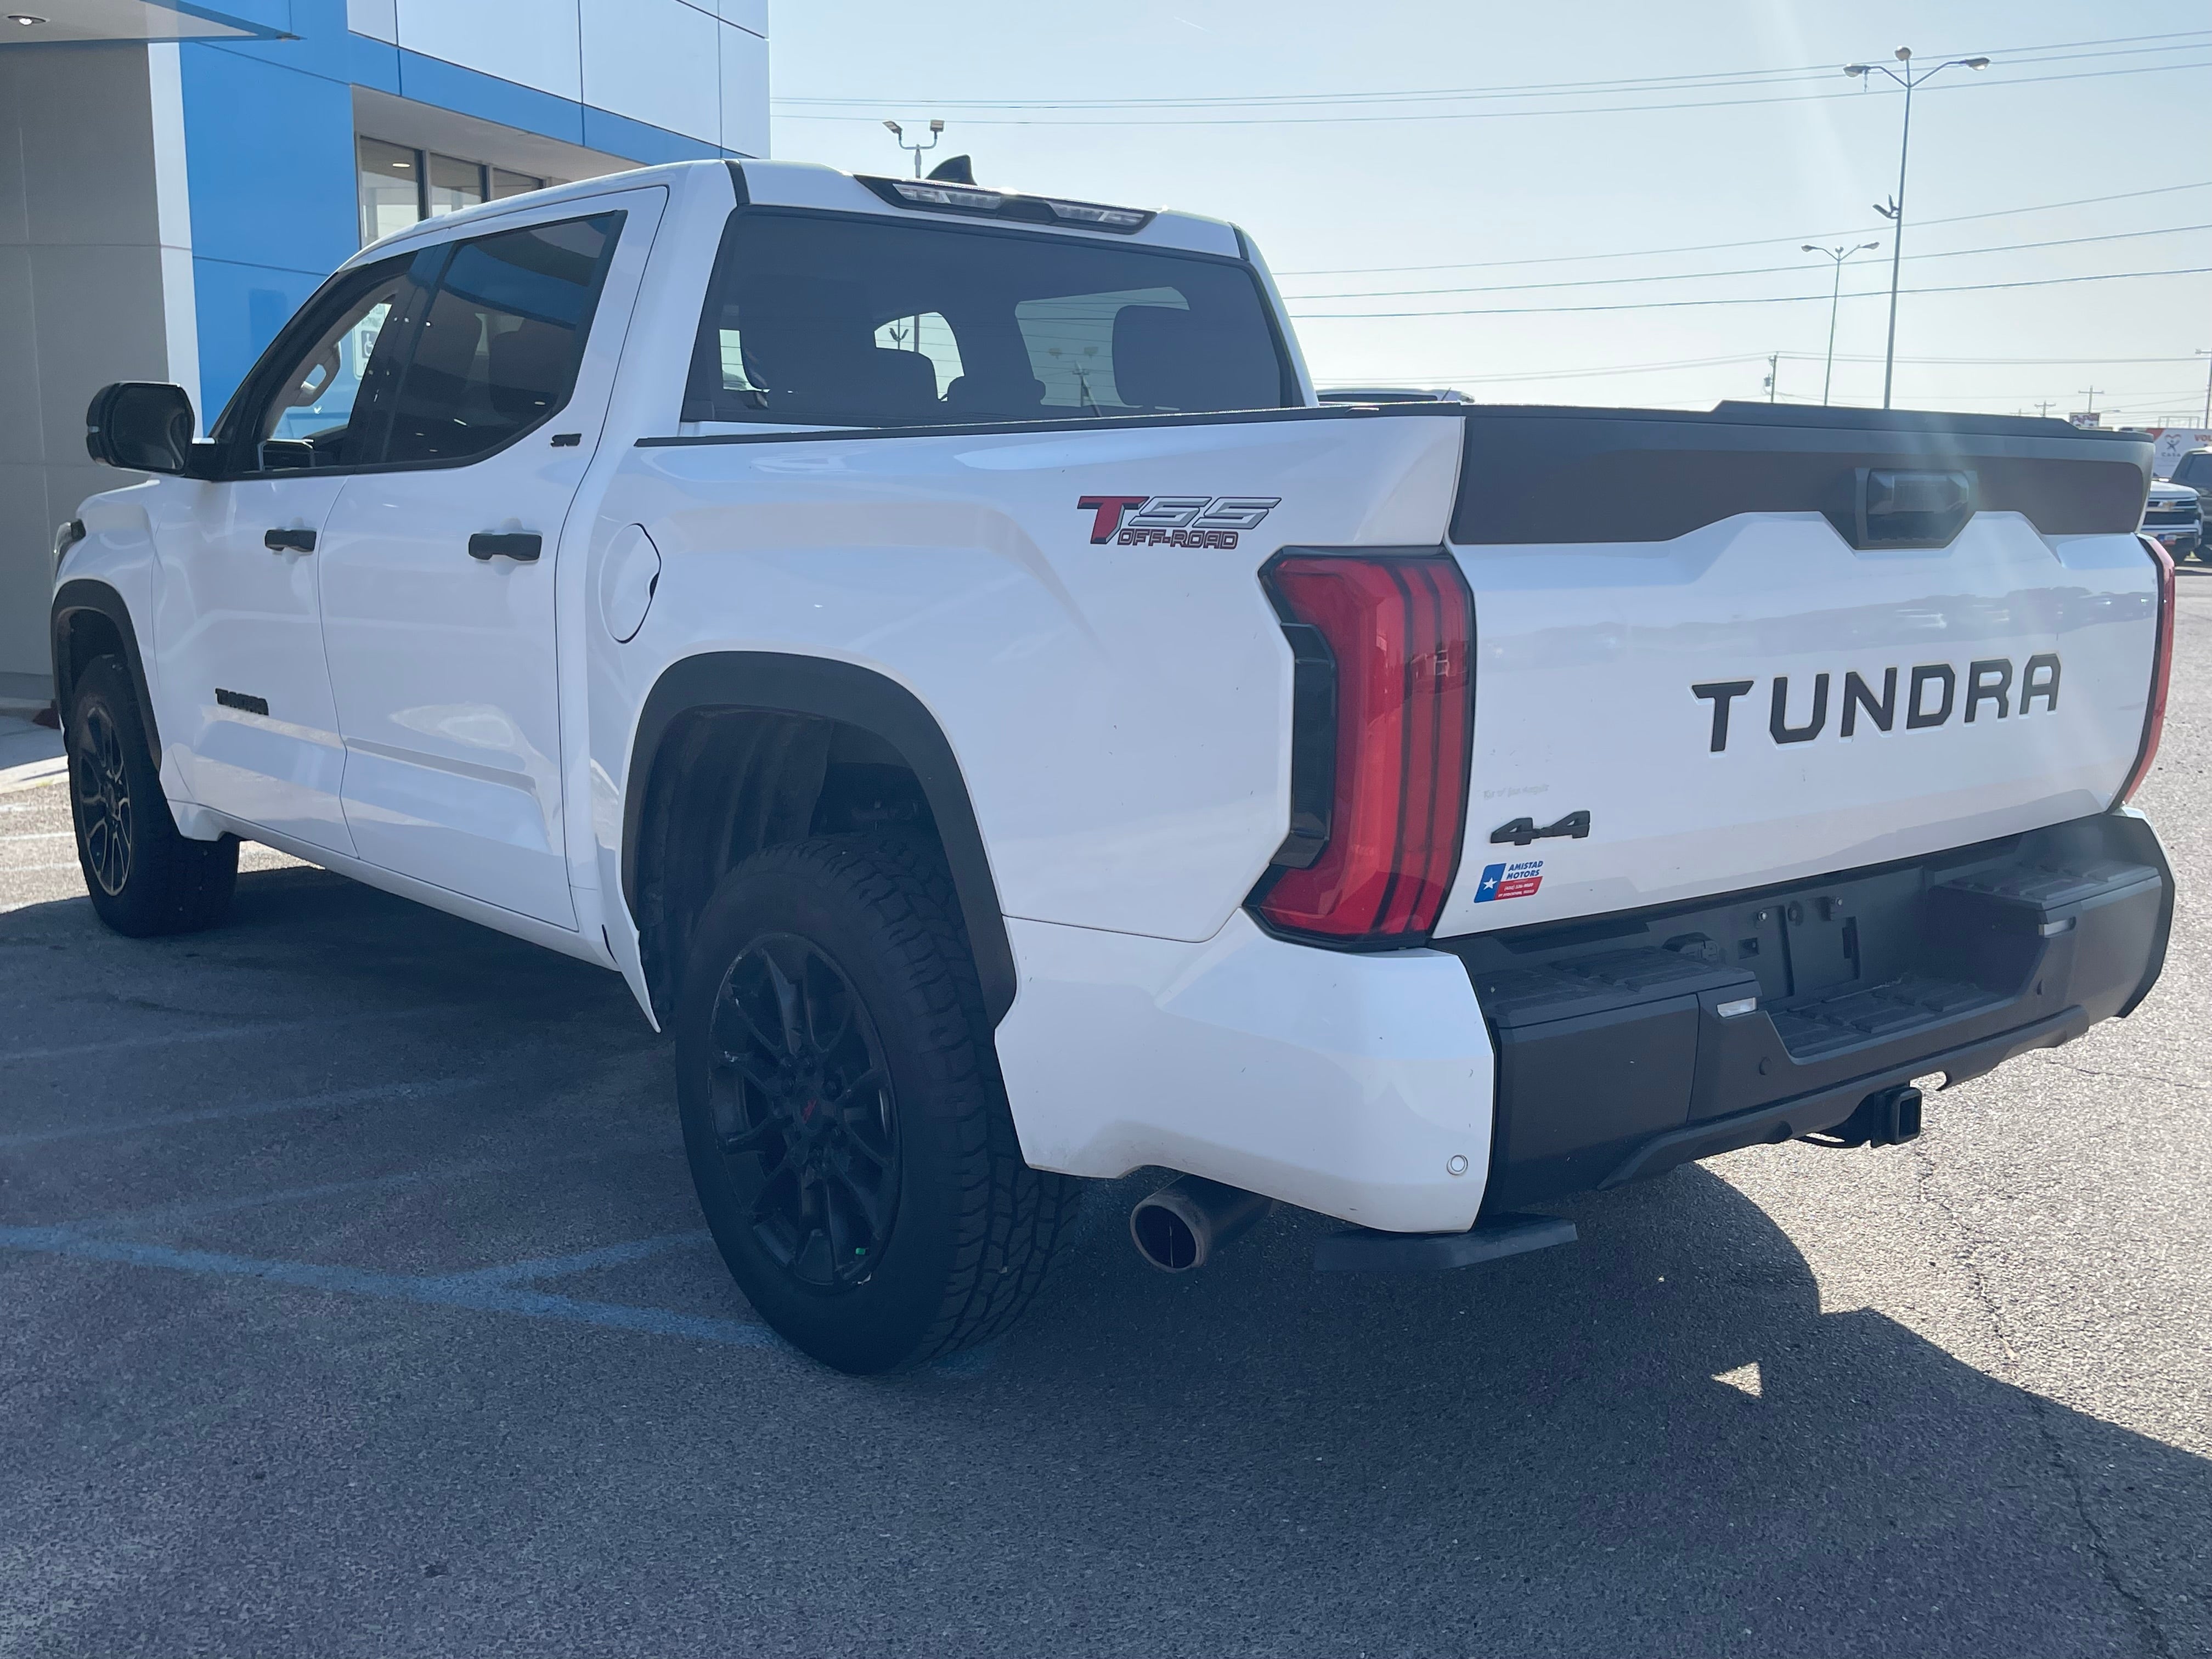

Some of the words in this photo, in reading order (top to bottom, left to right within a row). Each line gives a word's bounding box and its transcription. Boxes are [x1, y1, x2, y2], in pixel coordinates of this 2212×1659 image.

[1117, 528, 1239, 549] OFF-ROAD
[1691, 653, 2061, 752] TUNDRA
[1508, 861, 1543, 871] AMISTAD
[1506, 869, 1540, 880] MOTORS
